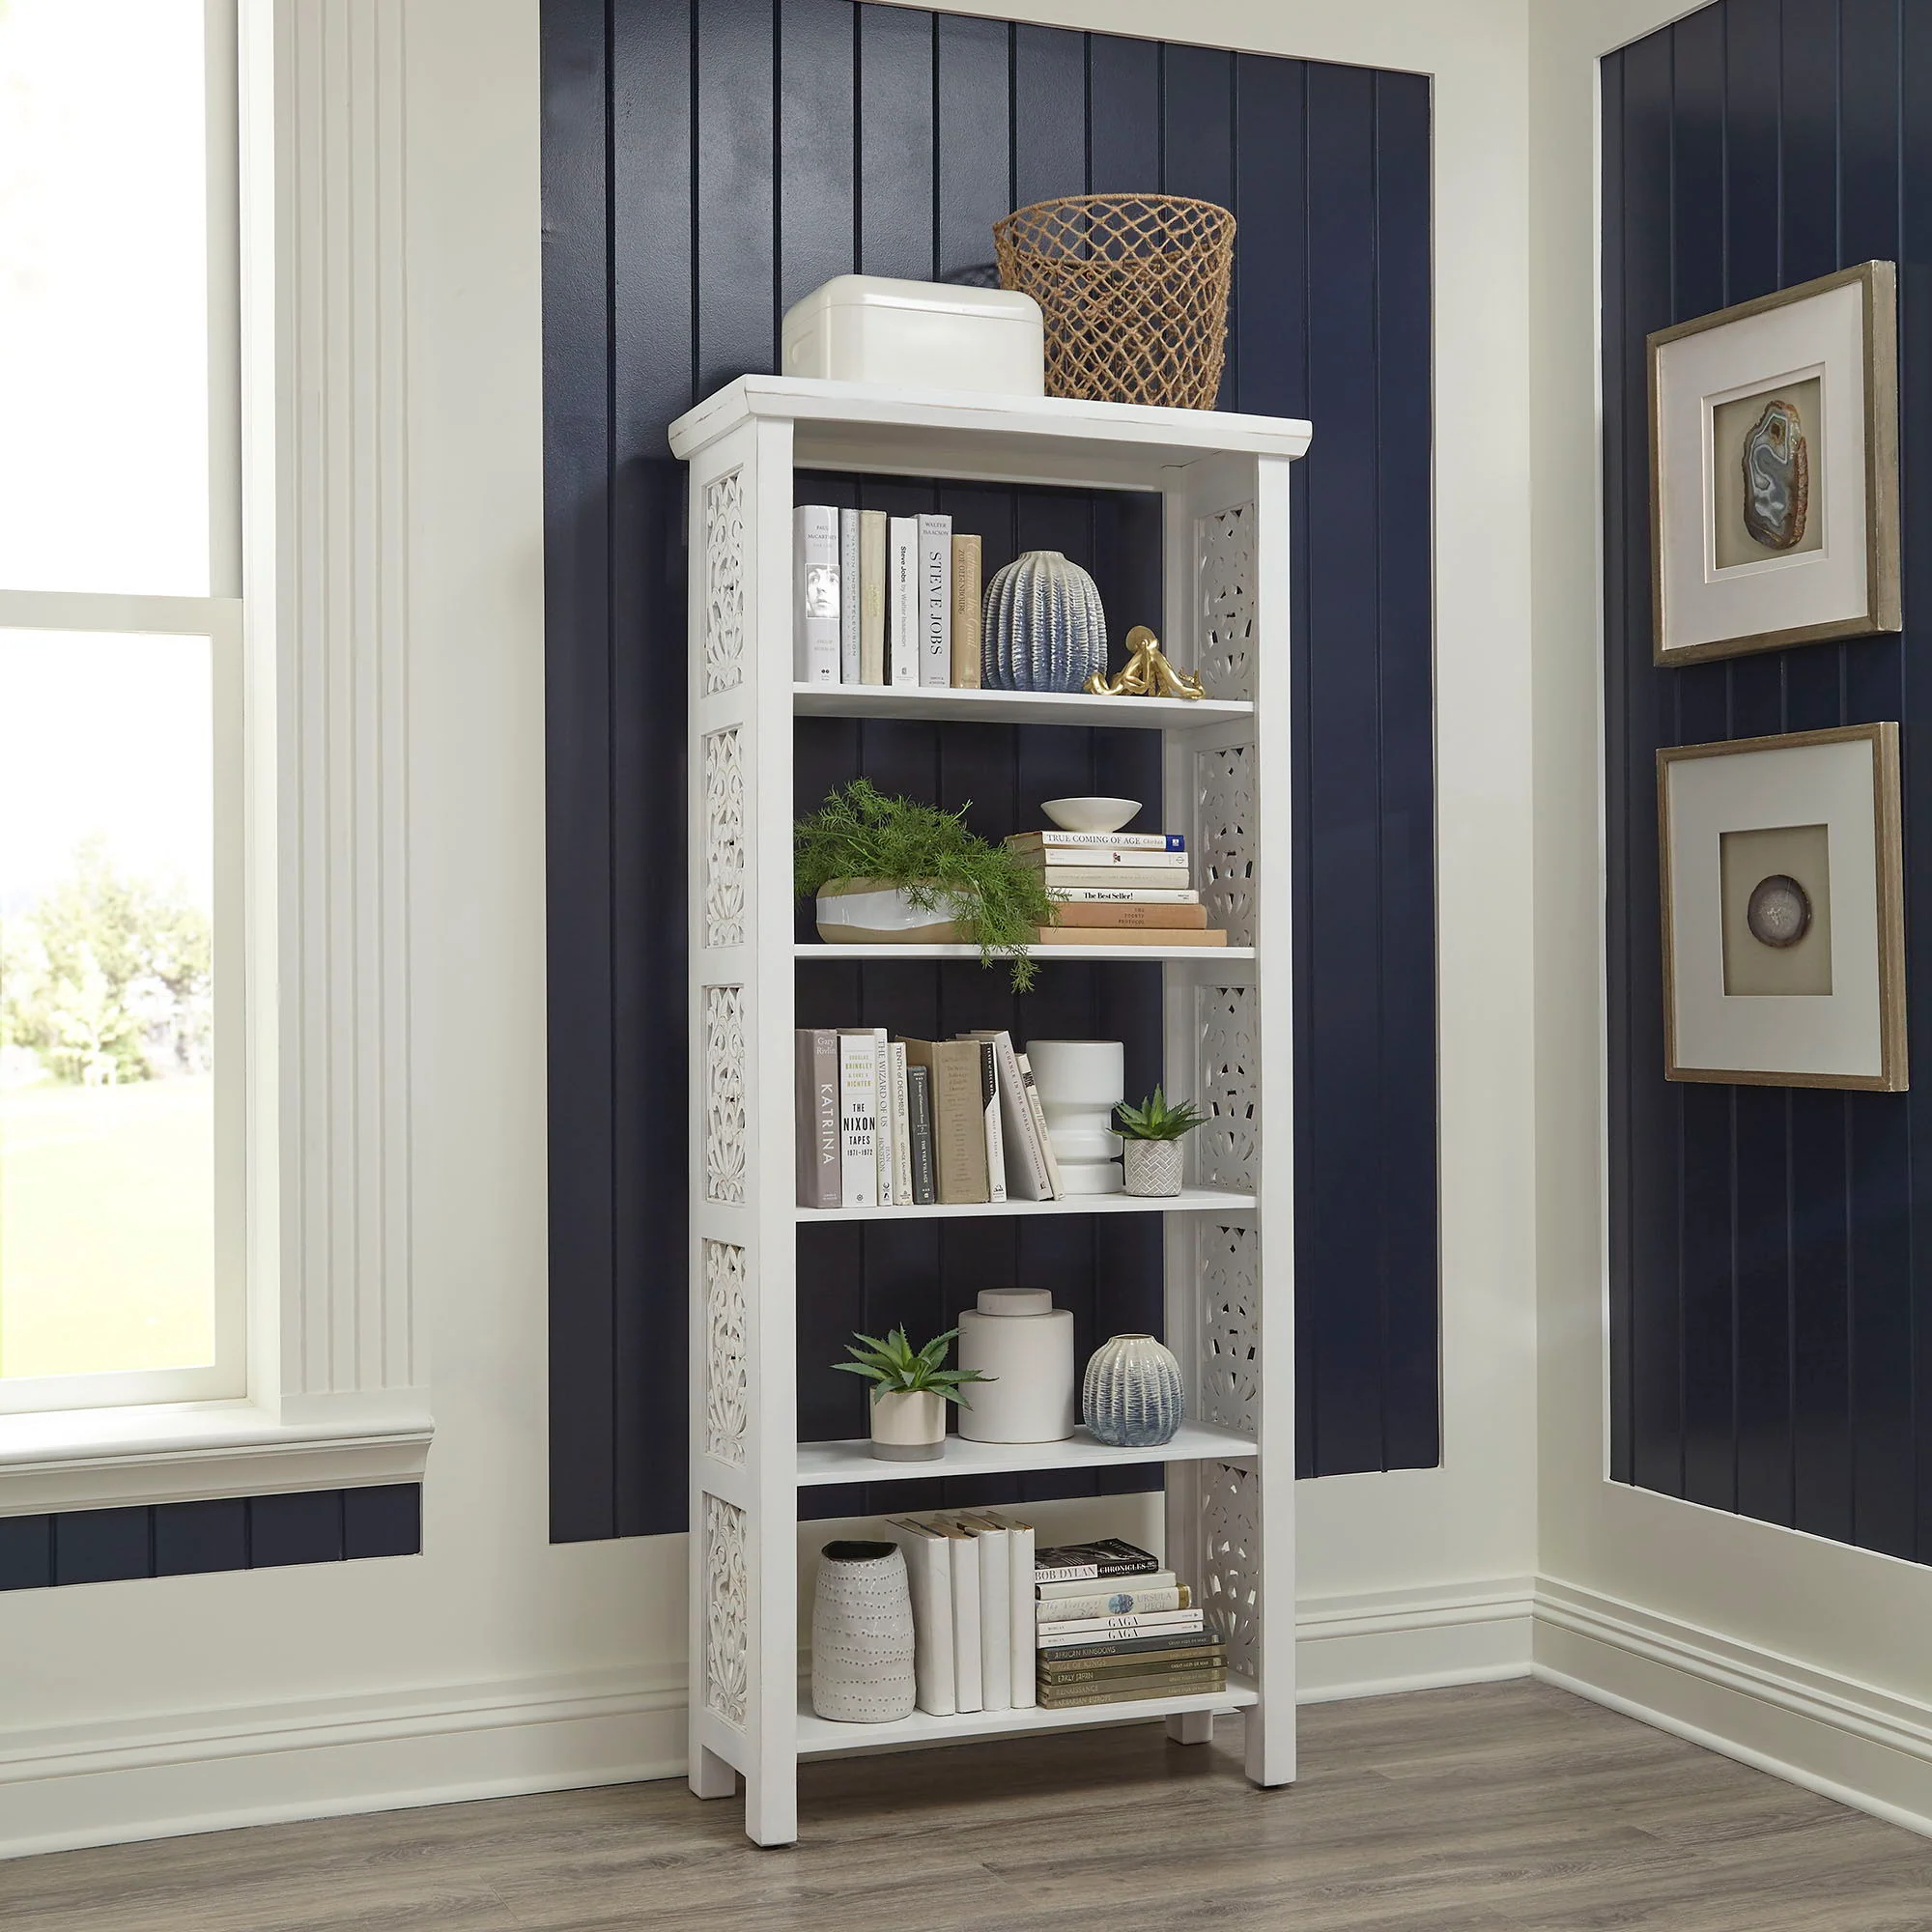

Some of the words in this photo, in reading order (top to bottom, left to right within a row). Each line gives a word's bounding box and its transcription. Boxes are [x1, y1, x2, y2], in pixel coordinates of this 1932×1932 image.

[929, 551, 943, 609] STEVE
[930, 613, 943, 655] JOBS
[1047, 834, 1071, 842] TRUE
[1072, 835, 1109, 843] COMING
[1123, 836, 1141, 845] AGE
[1112, 892, 1134, 900] Seller!
[817, 1037, 835, 1047] Gary
[816, 1046, 838, 1055] Rivlin
[877, 1038, 886, 1059] THE
[878, 1060, 887, 1099] WIZARD
[1005, 1050, 1016, 1078] CHANCE
[1021, 1108, 1031, 1132] WORLD
[896, 1079, 905, 1118] DECEMBER
[852, 1103, 865, 1112] THE
[880, 1100, 888, 1114] OF
[821, 1083, 836, 1164] KATRINA
[843, 1117, 875, 1131] NIXON
[881, 1116, 889, 1127] US
[849, 1135, 870, 1145] TAPES
[1035, 1571, 1056, 1581] BOB
[1060, 1566, 1096, 1578] DYLAN
[1099, 1563, 1146, 1575] CHRONICLES
[1136, 1592, 1173, 1603] URSULA
[1108, 1616, 1138, 1627] GAGA
[1108, 1629, 1138, 1638] GAGA
[1055, 1649, 1081, 1659] AFRICAN
[1082, 1646, 1117, 1656] KINGDOMS
[1082, 1660, 1106, 1668] KINGS
[1058, 1674, 1074, 1683] EARLY
[1075, 1671, 1094, 1681] JAPAN
